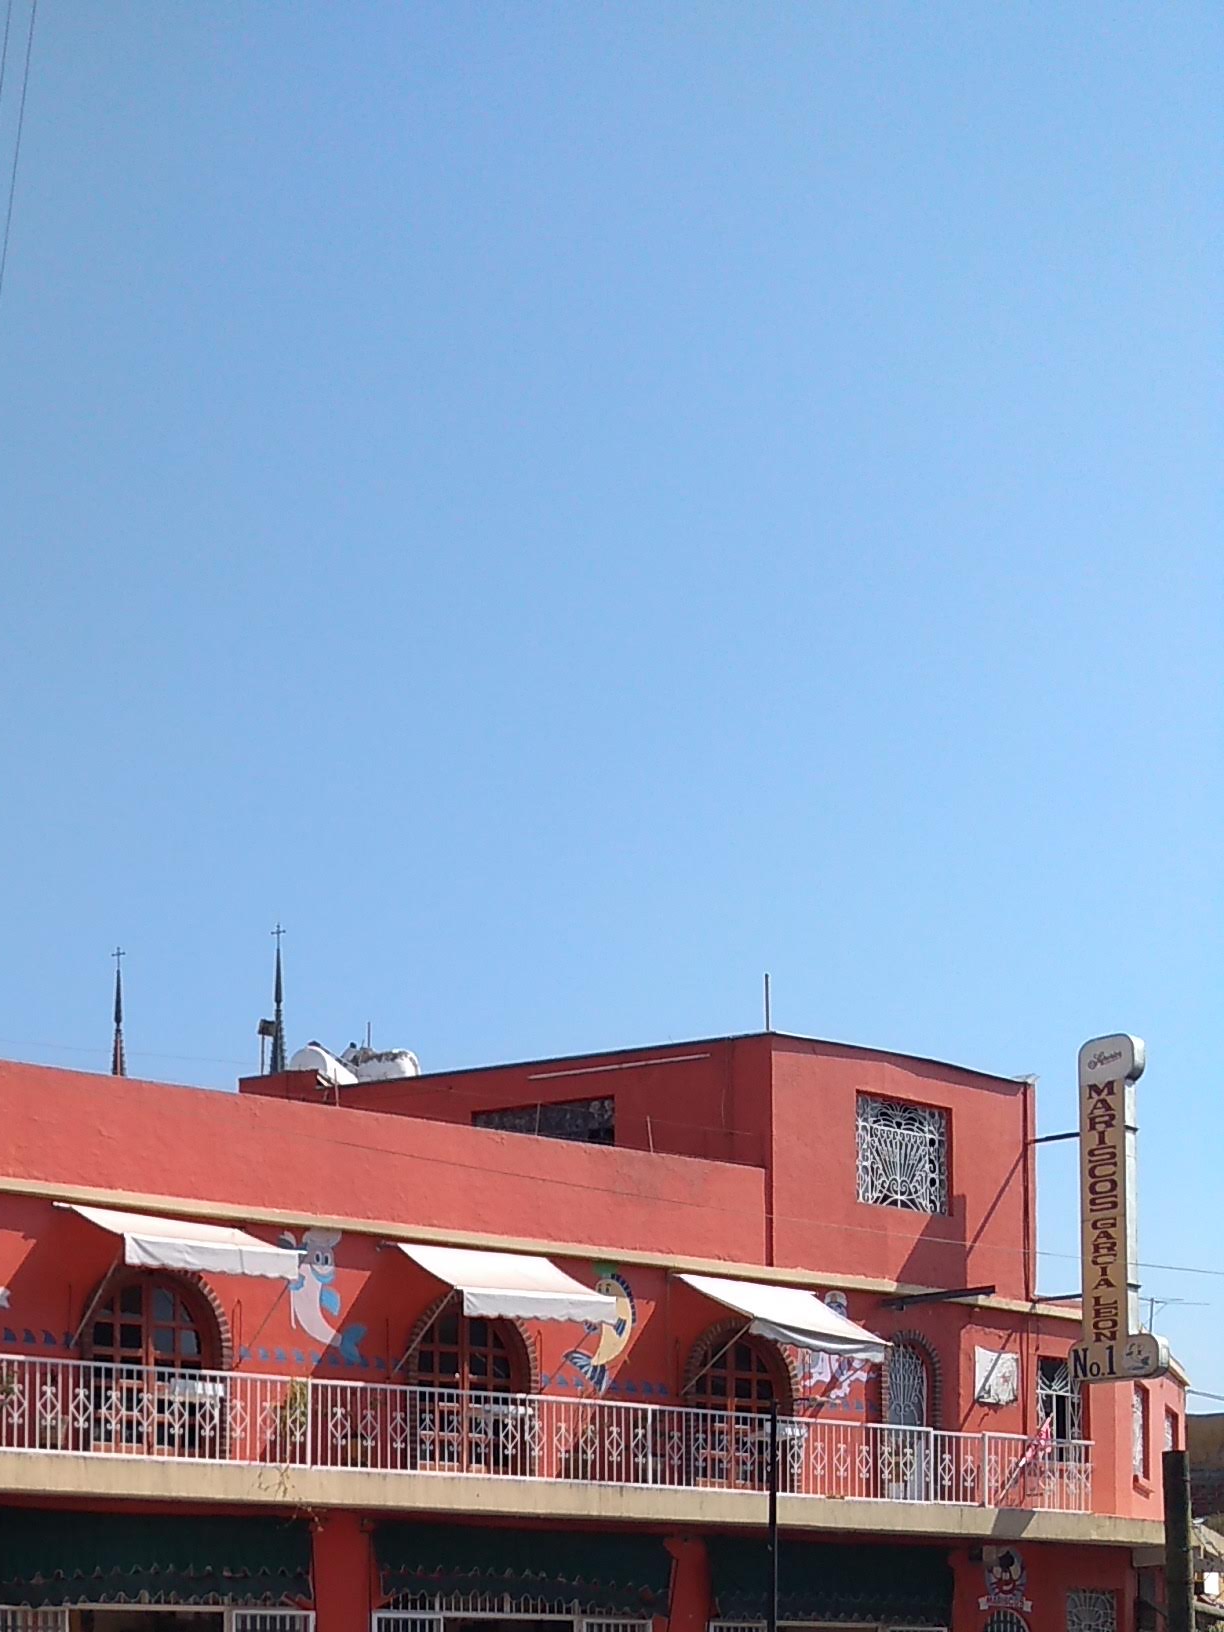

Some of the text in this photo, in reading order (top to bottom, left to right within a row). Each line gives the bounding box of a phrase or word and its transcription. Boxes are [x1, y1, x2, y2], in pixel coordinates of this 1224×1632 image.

[1087, 1080, 1119, 1343] MARISCOS GARCIA LEON
[1072, 1345, 1117, 1379] No.1
